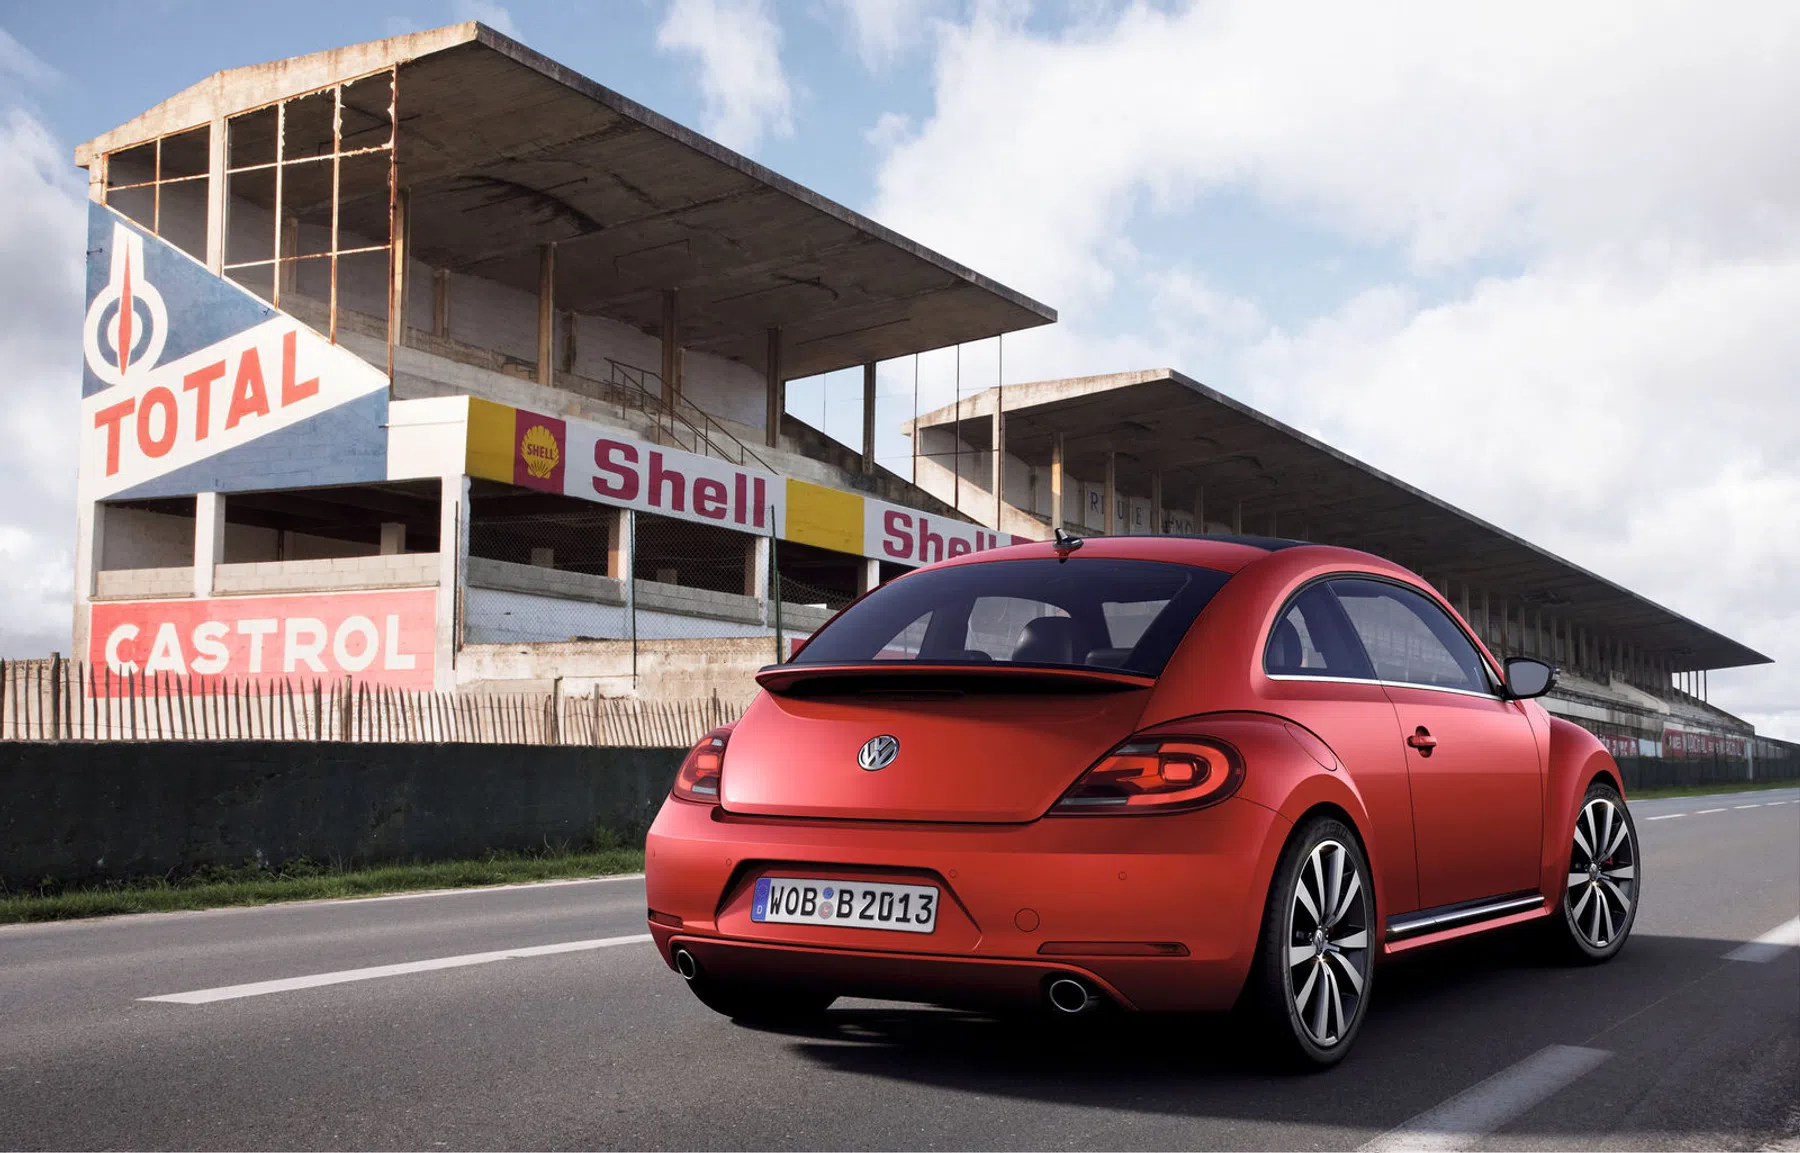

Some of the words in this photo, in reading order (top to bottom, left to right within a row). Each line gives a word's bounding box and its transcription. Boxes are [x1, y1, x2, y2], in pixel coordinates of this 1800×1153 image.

[94, 330, 320, 477] TOTAL
[527, 443, 555, 461] SHELL
[592, 438, 766, 528] Shell
[104, 614, 417, 677] CASTROL
[756, 905, 763, 915] D
[769, 886, 818, 916] WOB
